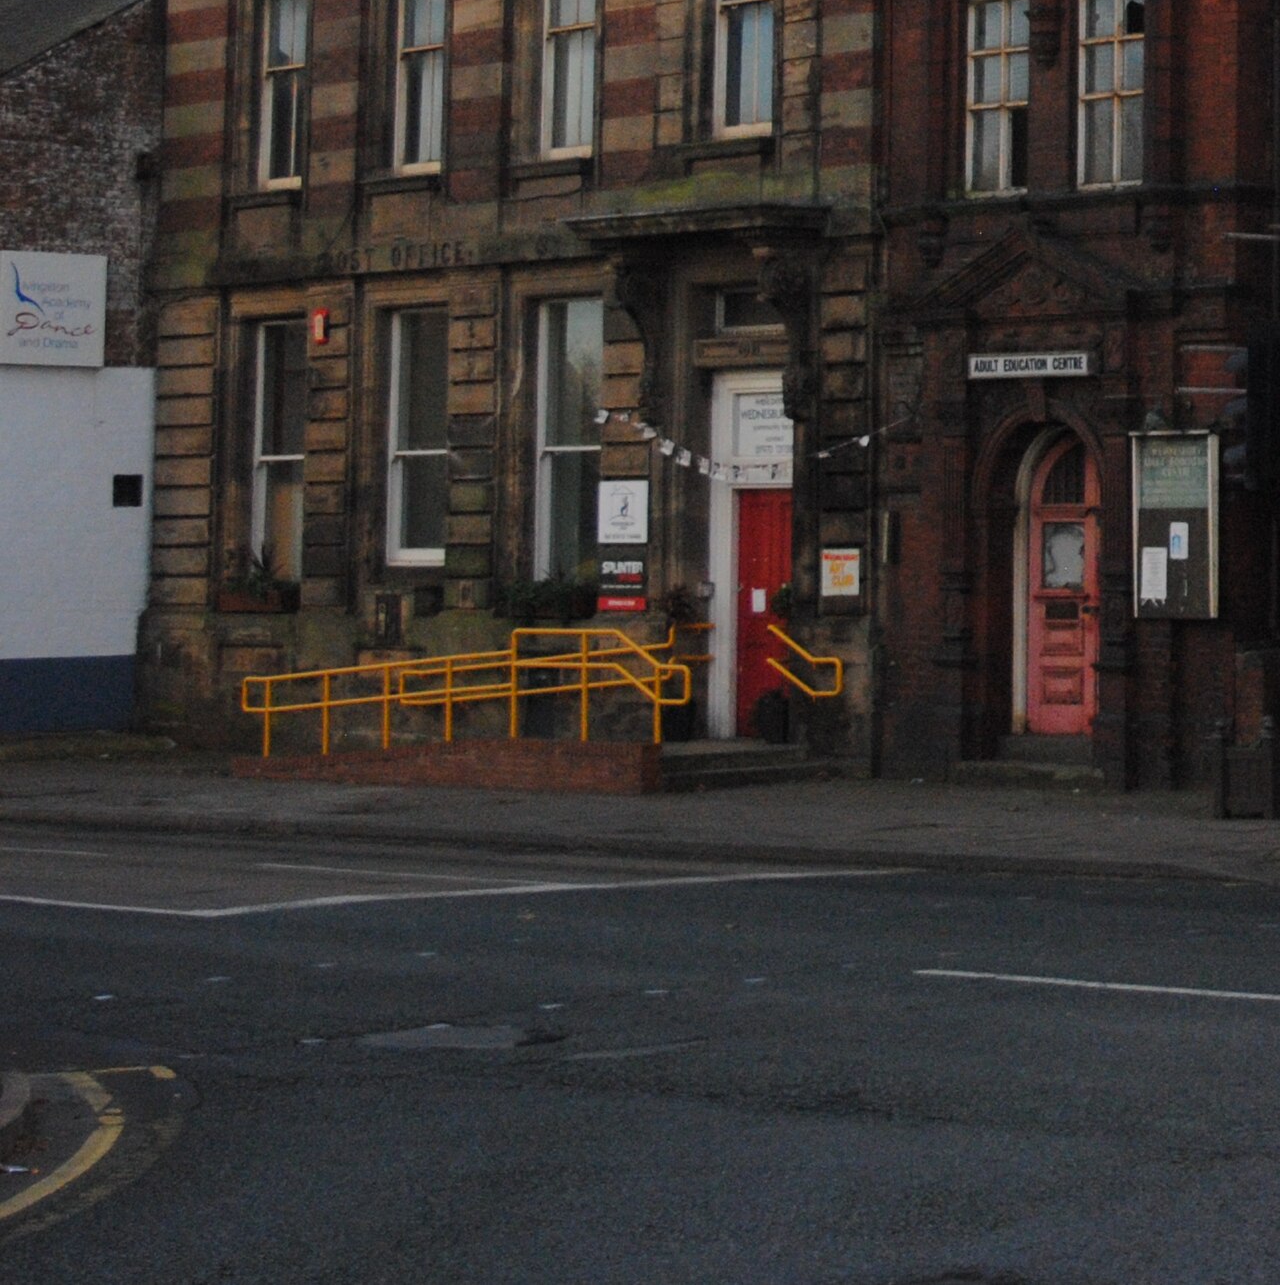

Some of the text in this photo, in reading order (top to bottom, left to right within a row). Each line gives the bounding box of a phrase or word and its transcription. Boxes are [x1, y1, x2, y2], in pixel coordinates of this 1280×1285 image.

[42, 298, 92, 309] Academy
[54, 311, 65, 320] of
[6, 311, 99, 337] Dance
[18, 337, 79, 349] and Drama
[974, 356, 1083, 372] ADULT EDUCATION CENTRE
[602, 561, 643, 574] SPLINTER
